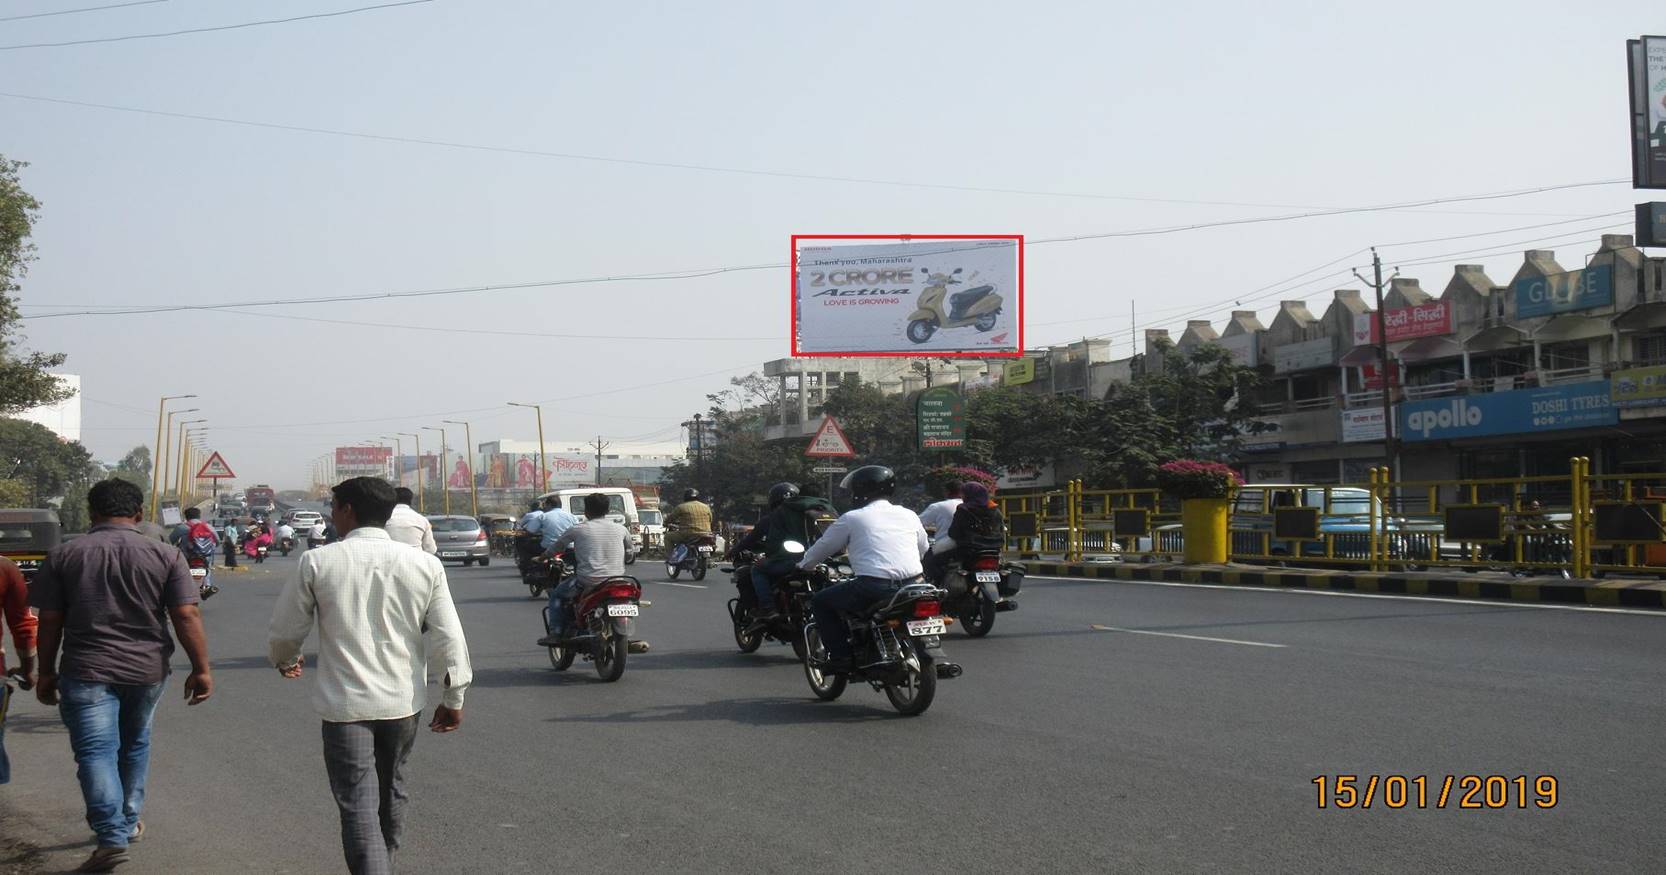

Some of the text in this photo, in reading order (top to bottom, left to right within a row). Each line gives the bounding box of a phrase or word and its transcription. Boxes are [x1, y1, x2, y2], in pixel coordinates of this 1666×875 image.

[815, 258, 839, 266] Thank
[860, 256, 912, 265] Maharashtra
[810, 266, 914, 287] 2 CRORE
[811, 287, 912, 298] Activa
[1528, 271, 1598, 303] GLOBE
[858, 297, 900, 305] GROWING
[1531, 398, 1568, 414] DOSHI
[1570, 394, 1610, 410] TYRES
[1407, 399, 1482, 438] apollo
[911, 626, 943, 635] 877
